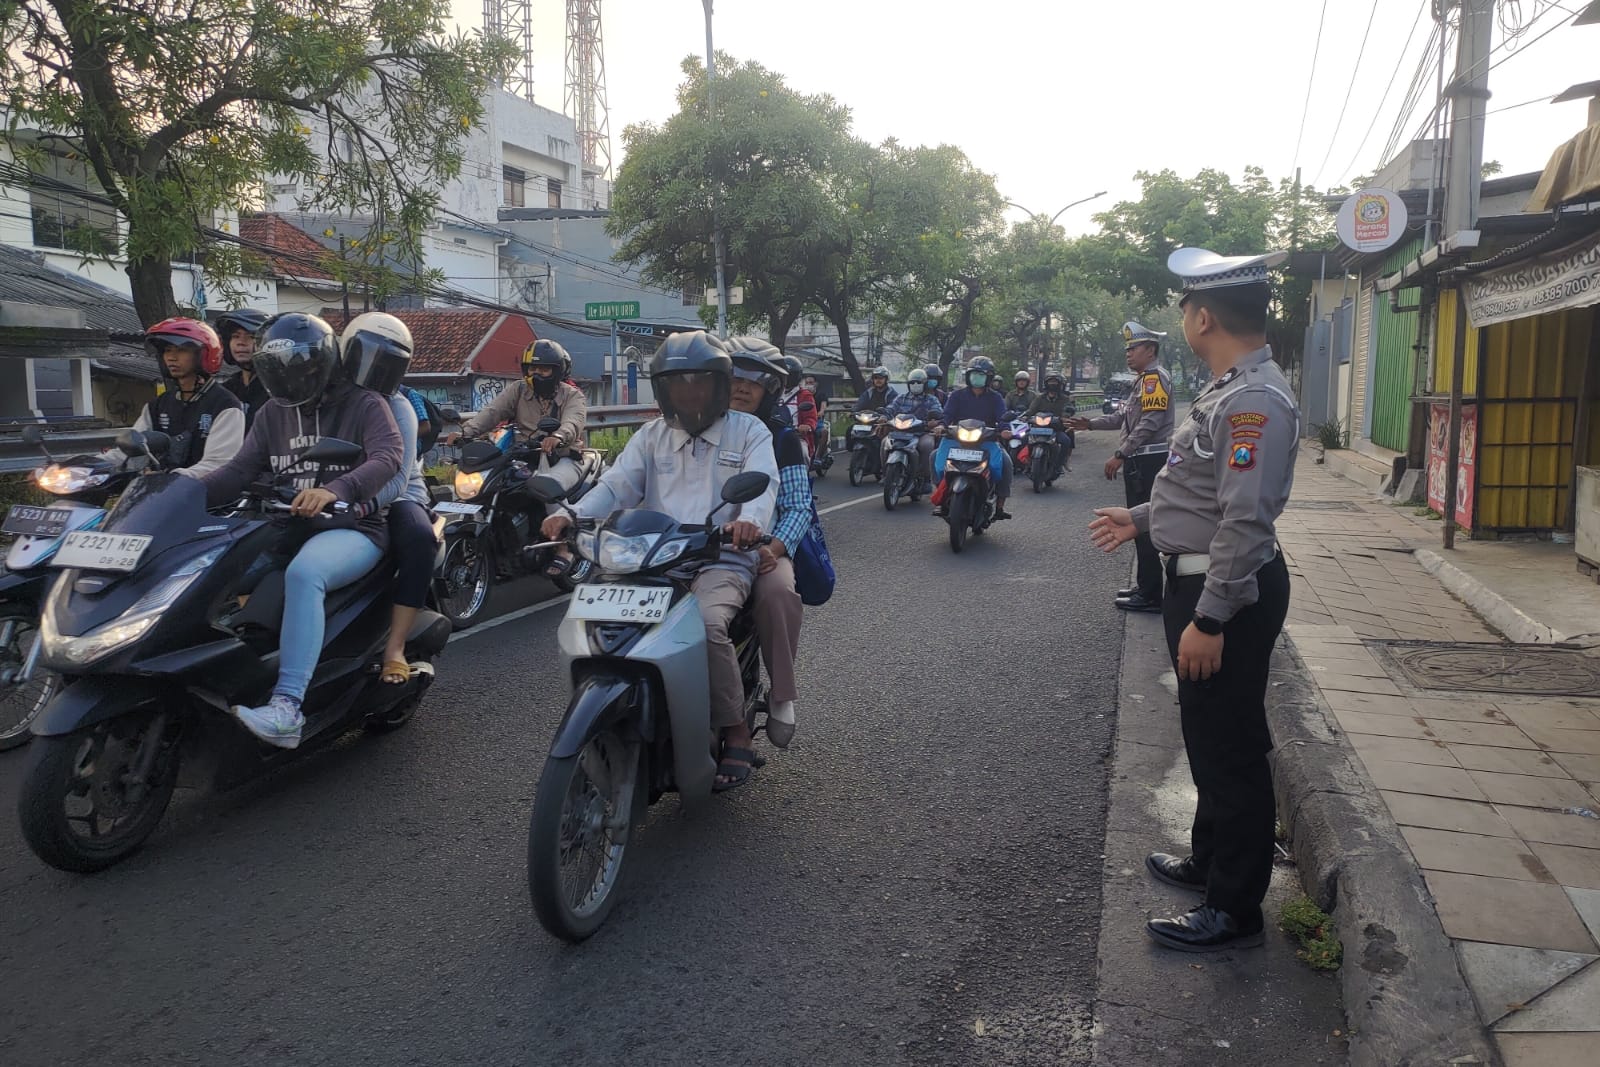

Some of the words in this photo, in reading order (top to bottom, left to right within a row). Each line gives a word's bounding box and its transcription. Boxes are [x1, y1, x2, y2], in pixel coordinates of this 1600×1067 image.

[1565, 275, 1589, 296] 700
[621, 304, 635, 316] URIP
[20, 508, 46, 520] 5231
[66, 535, 77, 546] W
[80, 536, 113, 550] 2321
[118, 538, 146, 551] NEU
[578, 587, 585, 601] L
[597, 588, 635, 603] 2717
[647, 590, 668, 604] WY
